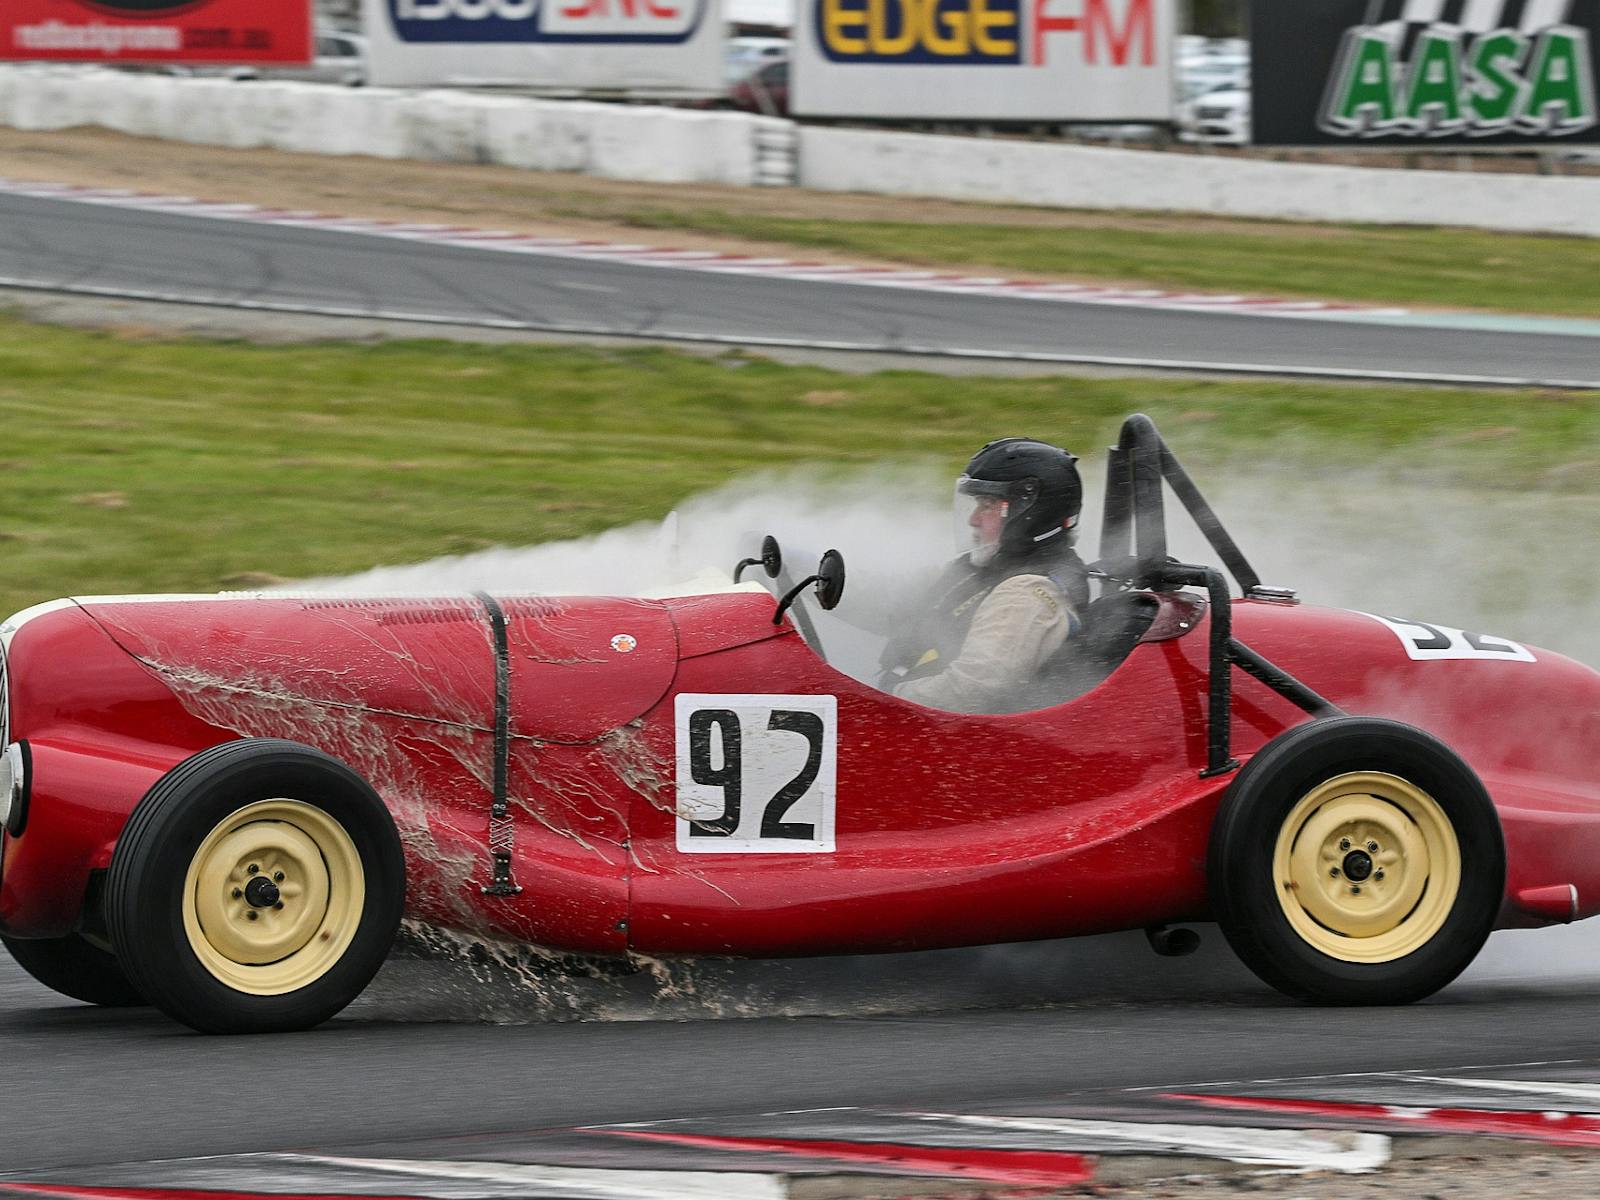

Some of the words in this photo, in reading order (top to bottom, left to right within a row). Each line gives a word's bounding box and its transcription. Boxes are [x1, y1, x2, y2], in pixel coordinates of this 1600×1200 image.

[824, 0, 1016, 56] EDGE
[1030, 0, 1158, 67] FM
[1320, 23, 1596, 136] AASA
[689, 708, 824, 841] 92
